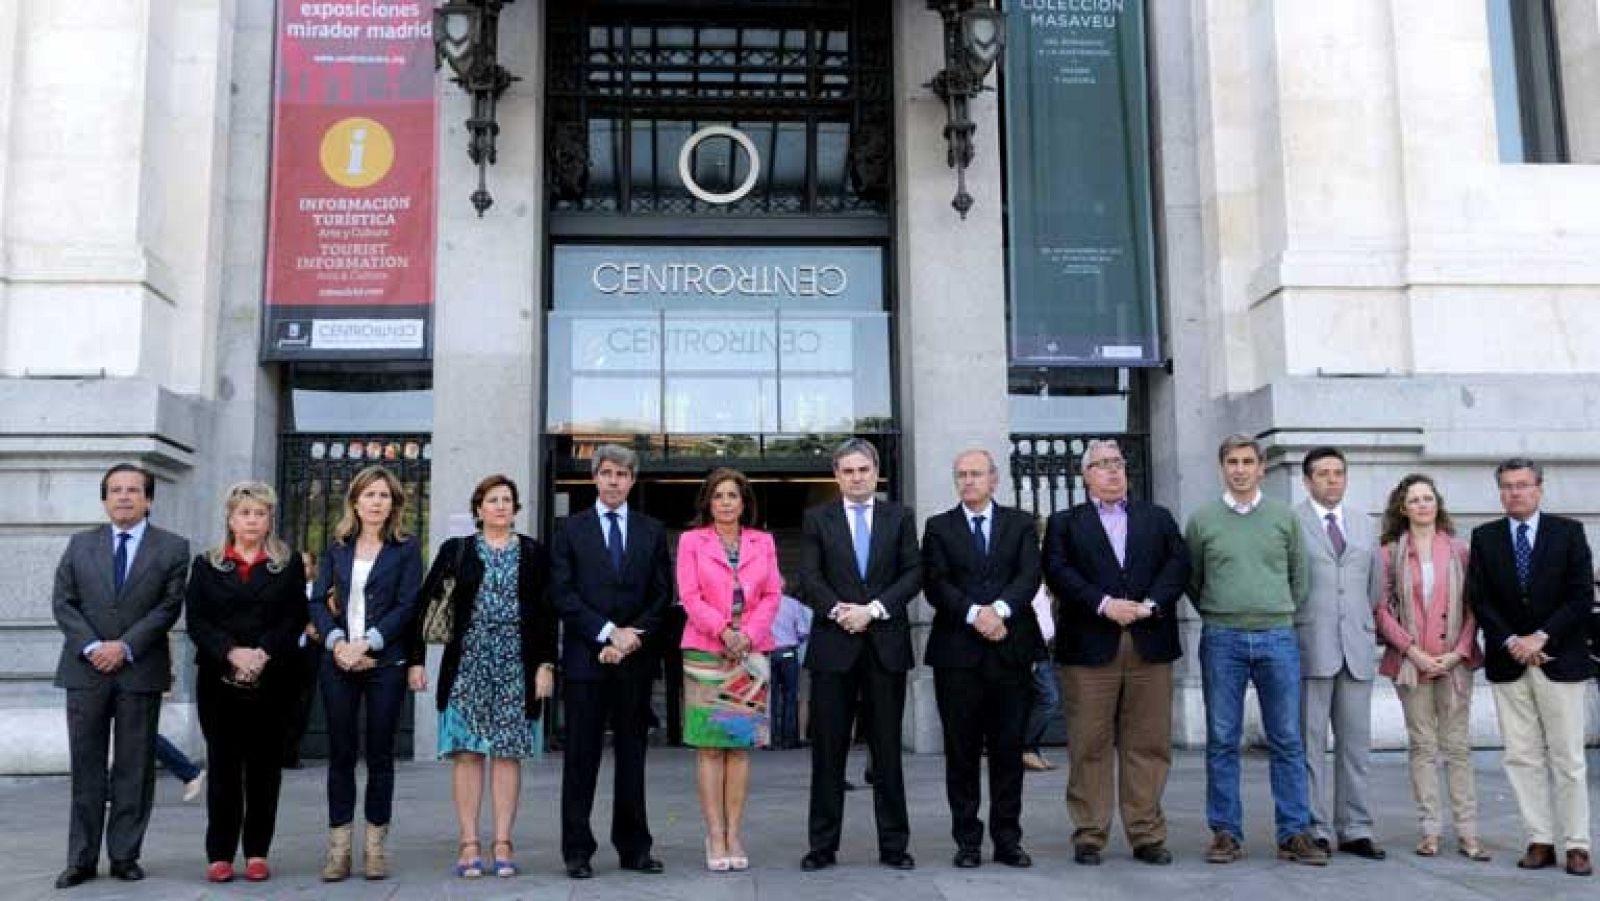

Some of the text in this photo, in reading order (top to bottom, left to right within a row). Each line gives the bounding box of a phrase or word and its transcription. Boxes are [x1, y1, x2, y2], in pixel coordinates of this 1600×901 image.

[301, 1, 420, 19] exposiciones
[1030, 14, 1116, 28] MASAVEU
[286, 20, 433, 39] mirador madrid
[299, 196, 411, 212] INFORMACIÓN
[319, 243, 389, 256] TOURIST
[297, 256, 410, 271] INFORMATION
